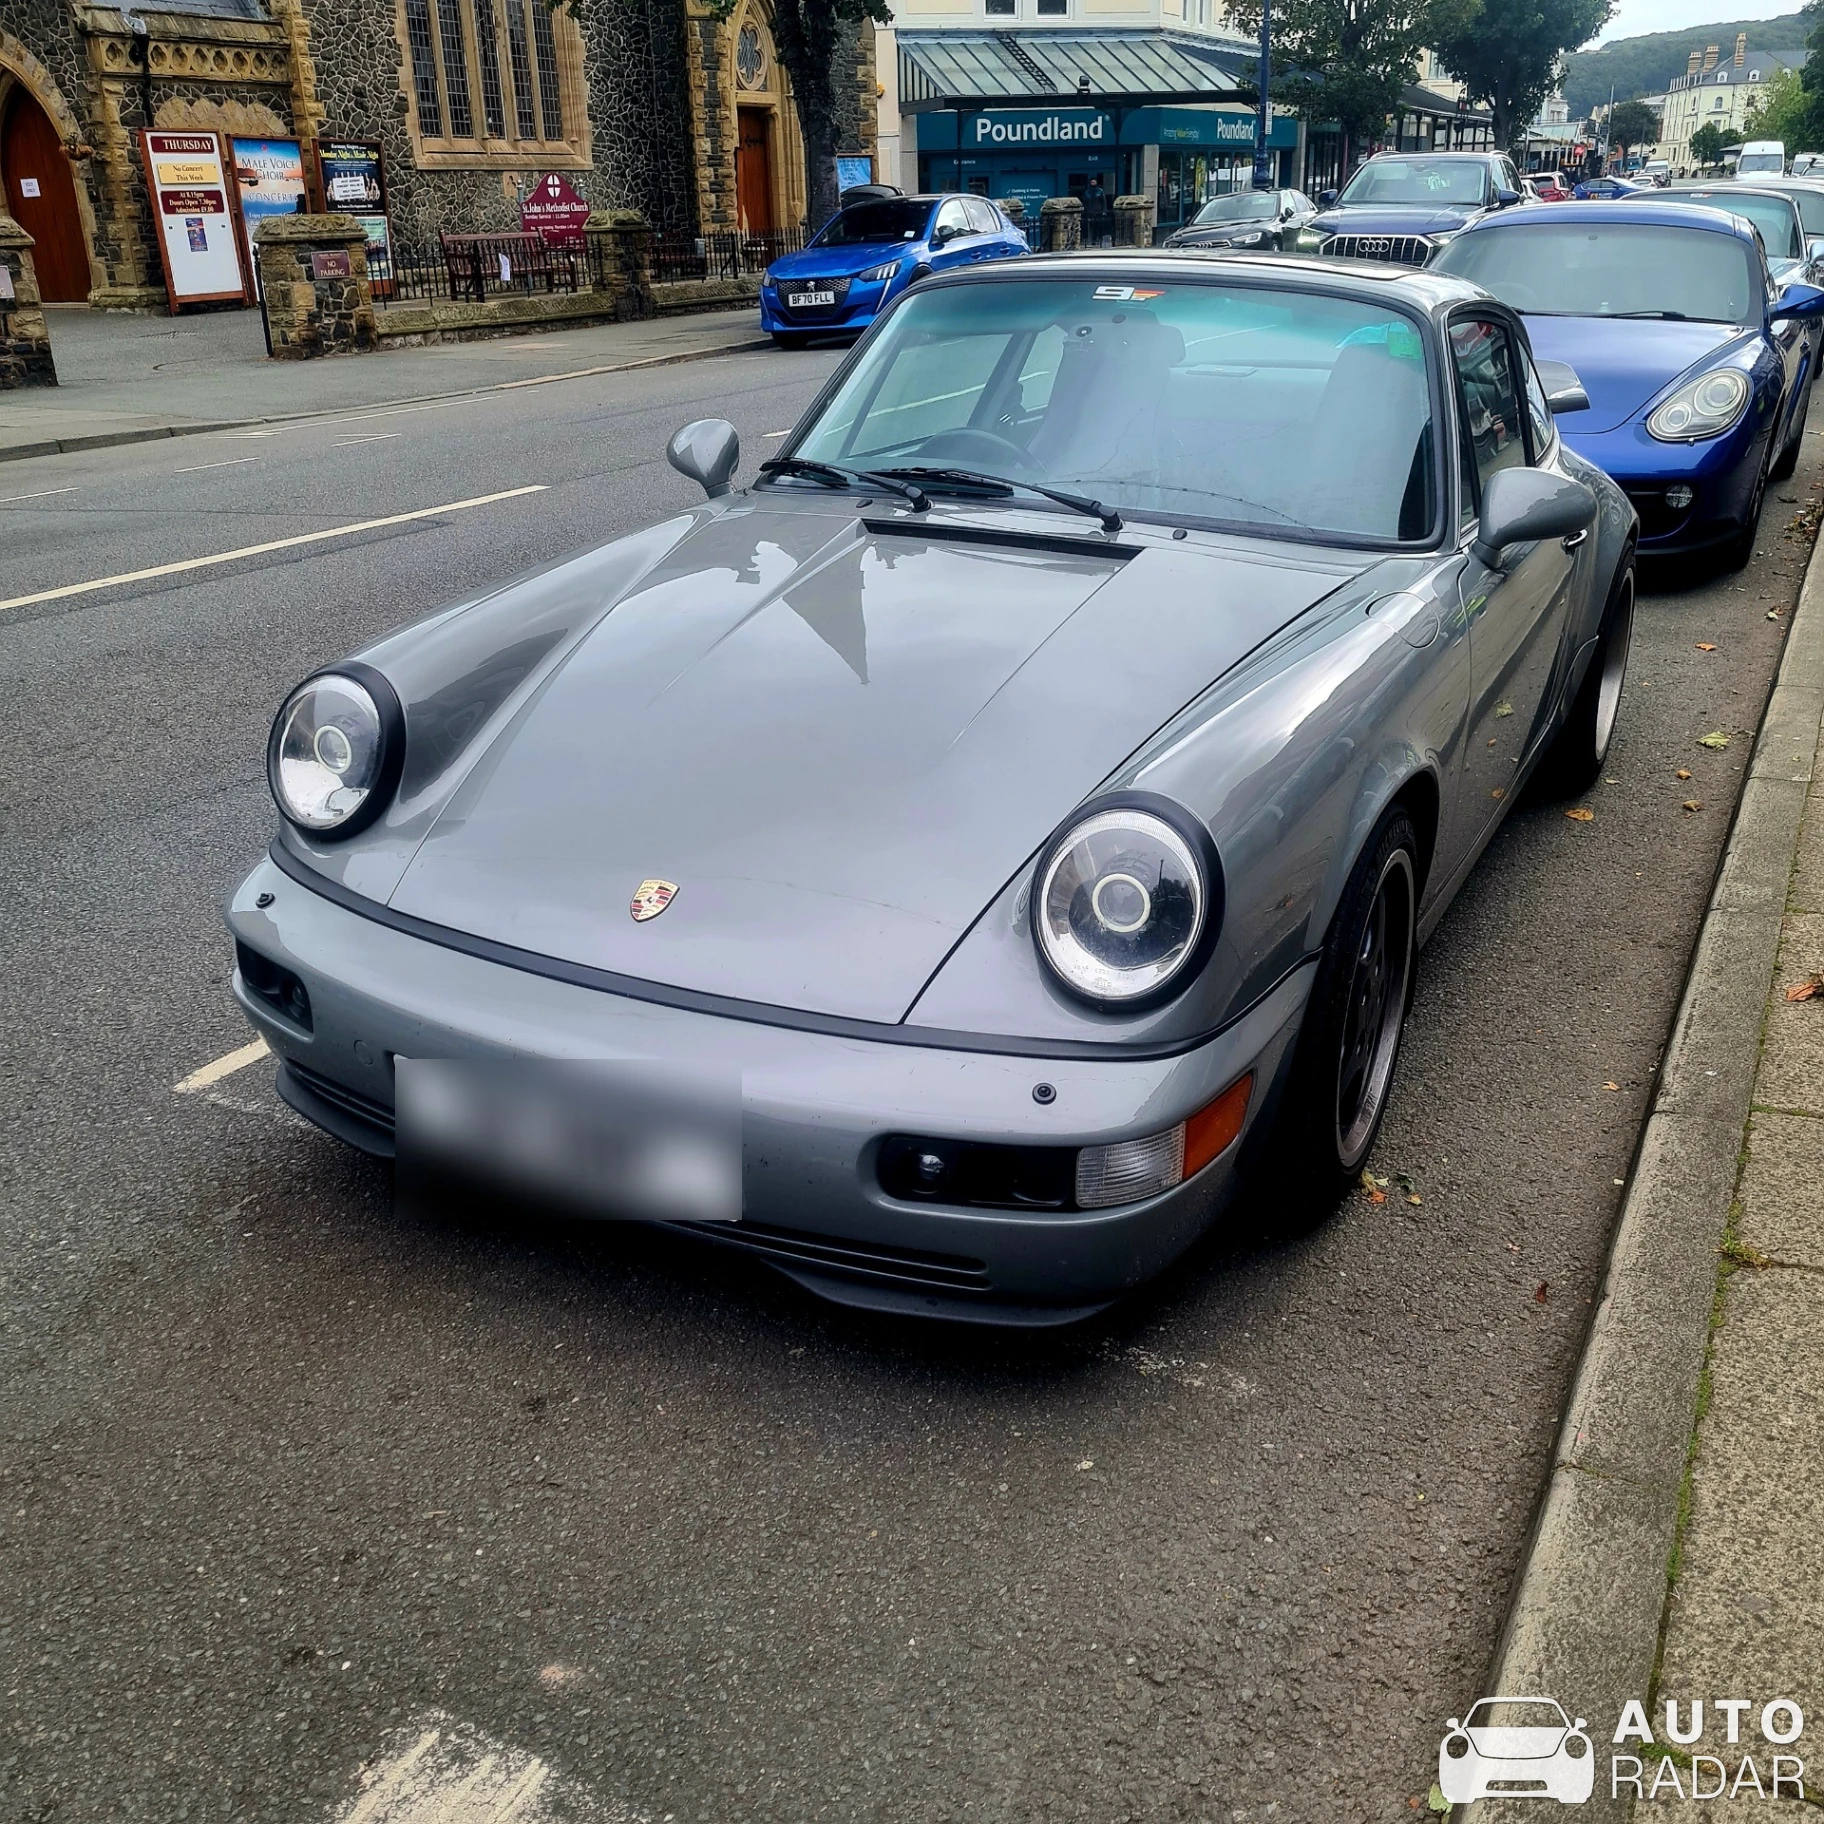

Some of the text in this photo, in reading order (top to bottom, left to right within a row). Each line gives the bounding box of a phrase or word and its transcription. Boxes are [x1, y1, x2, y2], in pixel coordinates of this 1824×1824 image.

[976, 115, 1103, 142] Poundland
[1216, 118, 1254, 140] Poundland
[163, 139, 212, 150] THURSDAY
[181, 164, 204, 172] Concert
[241, 158, 296, 169] MALE VOICE
[255, 169, 285, 180] CHOIR
[546, 202, 570, 212] Methodist
[571, 202, 588, 212] Church
[326, 260, 337, 268] NO
[320, 268, 345, 277] PARKING
[792, 293, 831, 305] BF70 FLL
